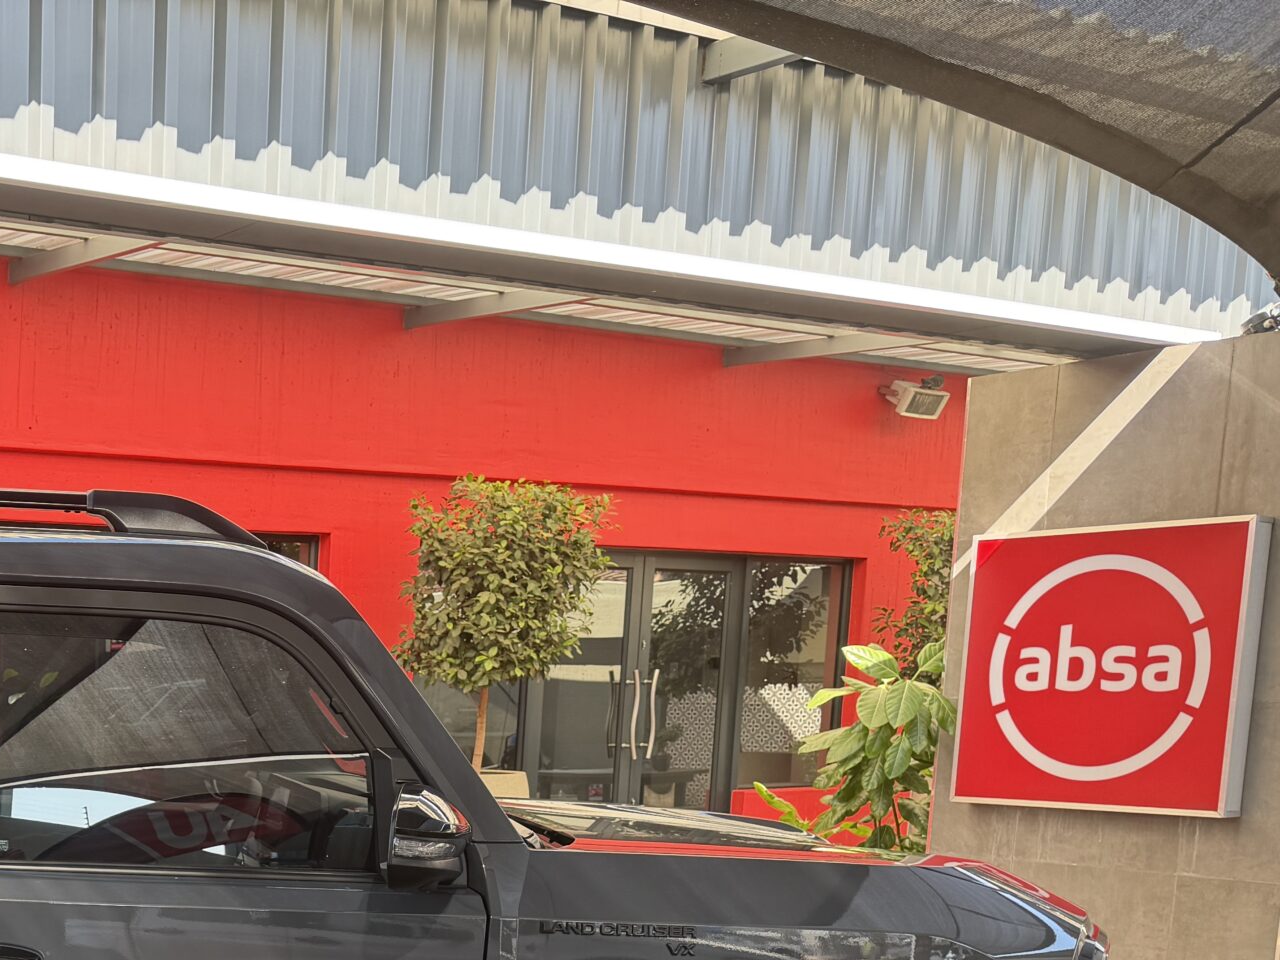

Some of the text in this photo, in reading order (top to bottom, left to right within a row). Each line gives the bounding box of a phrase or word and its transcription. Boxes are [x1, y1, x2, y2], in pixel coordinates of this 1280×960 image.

[1014, 623, 1183, 693] absa
[539, 919, 697, 939] LAND CRUISER
[666, 943, 696, 957] VX
